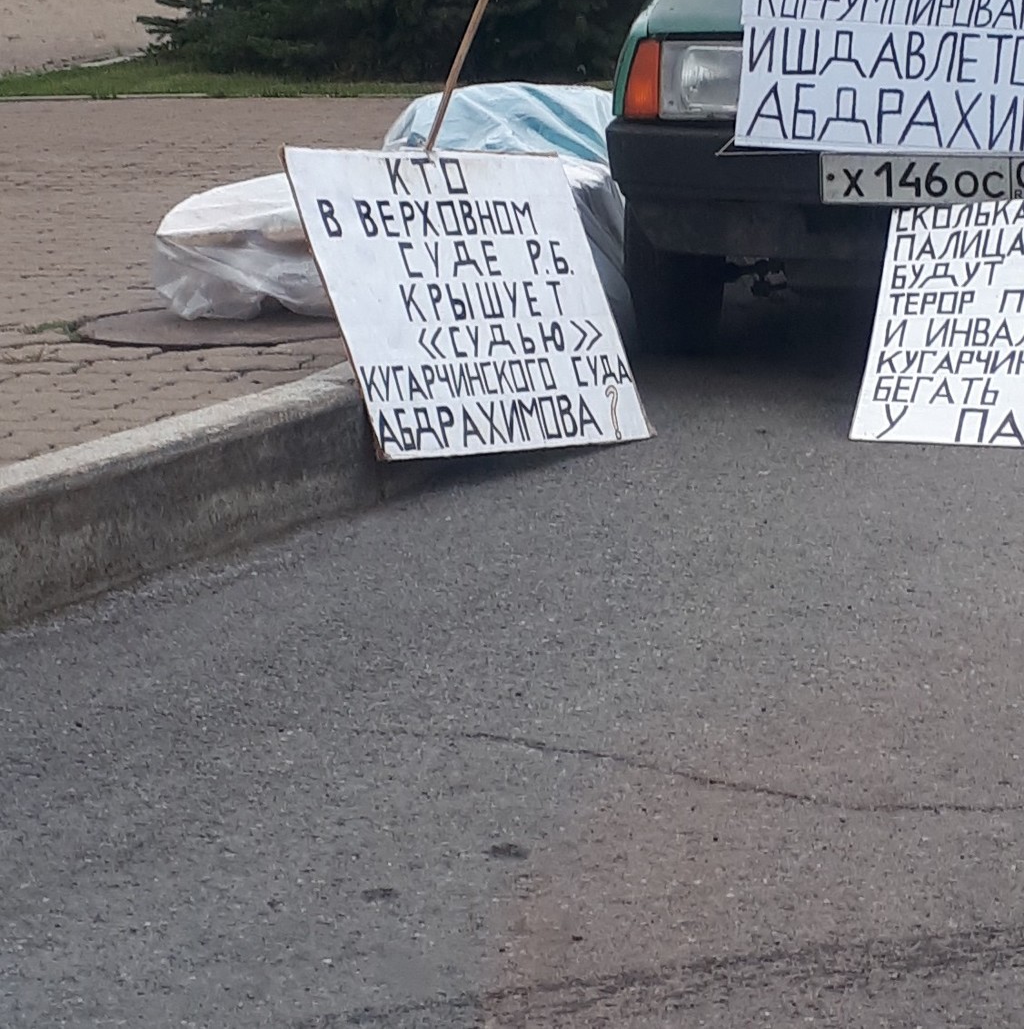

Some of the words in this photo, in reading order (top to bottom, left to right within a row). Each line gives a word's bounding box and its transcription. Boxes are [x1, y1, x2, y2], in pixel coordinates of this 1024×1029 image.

[385, 157, 469, 195] КТО
[316, 199, 343, 237] В
[353, 199, 538, 238] ВЕРХОВНОМ
[398, 241, 502, 278] СУДЕ
[891, 260, 1004, 289] БУДУТ
[399, 281, 565, 322] КРЫШУЕТ
[889, 290, 975, 315] ТЕРОР
[883, 319, 908, 347] И
[360, 358, 557, 403] КУГАРЧИНСКОГО
[571, 354, 633, 387] СУДА
[872, 376, 999, 406] БЕГАТЬ
[876, 404, 909, 439] У
